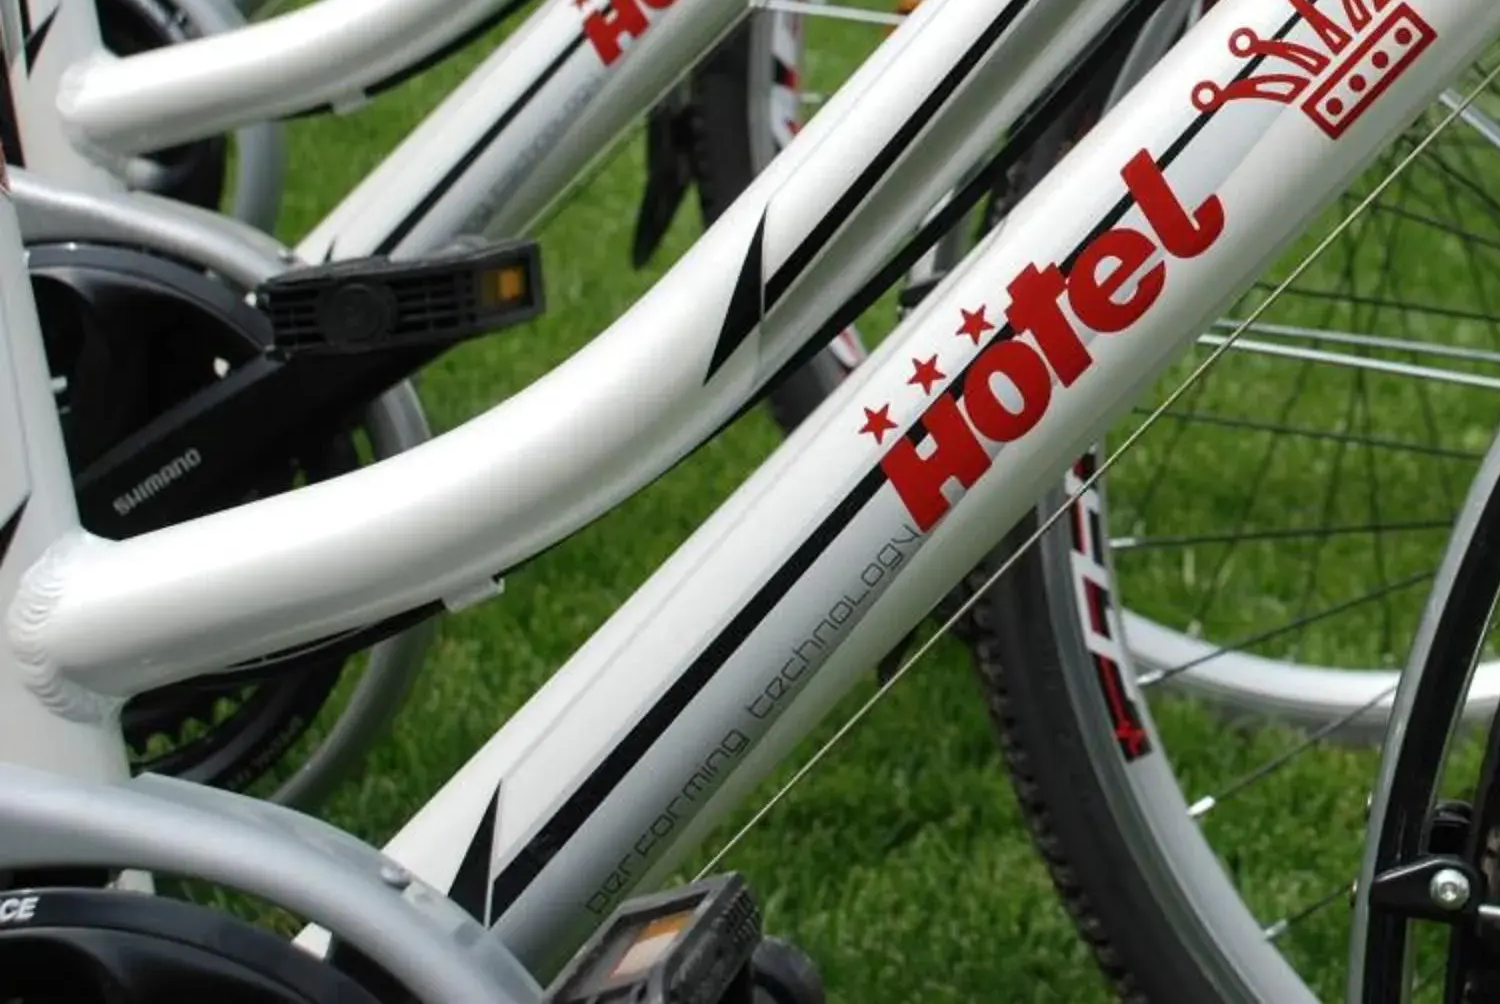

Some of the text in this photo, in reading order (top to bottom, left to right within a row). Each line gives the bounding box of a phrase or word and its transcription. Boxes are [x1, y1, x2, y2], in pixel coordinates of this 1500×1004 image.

[112, 448, 201, 517] SHIMANO
[879, 148, 1225, 533] Hotel
[584, 524, 922, 916] performing technology
